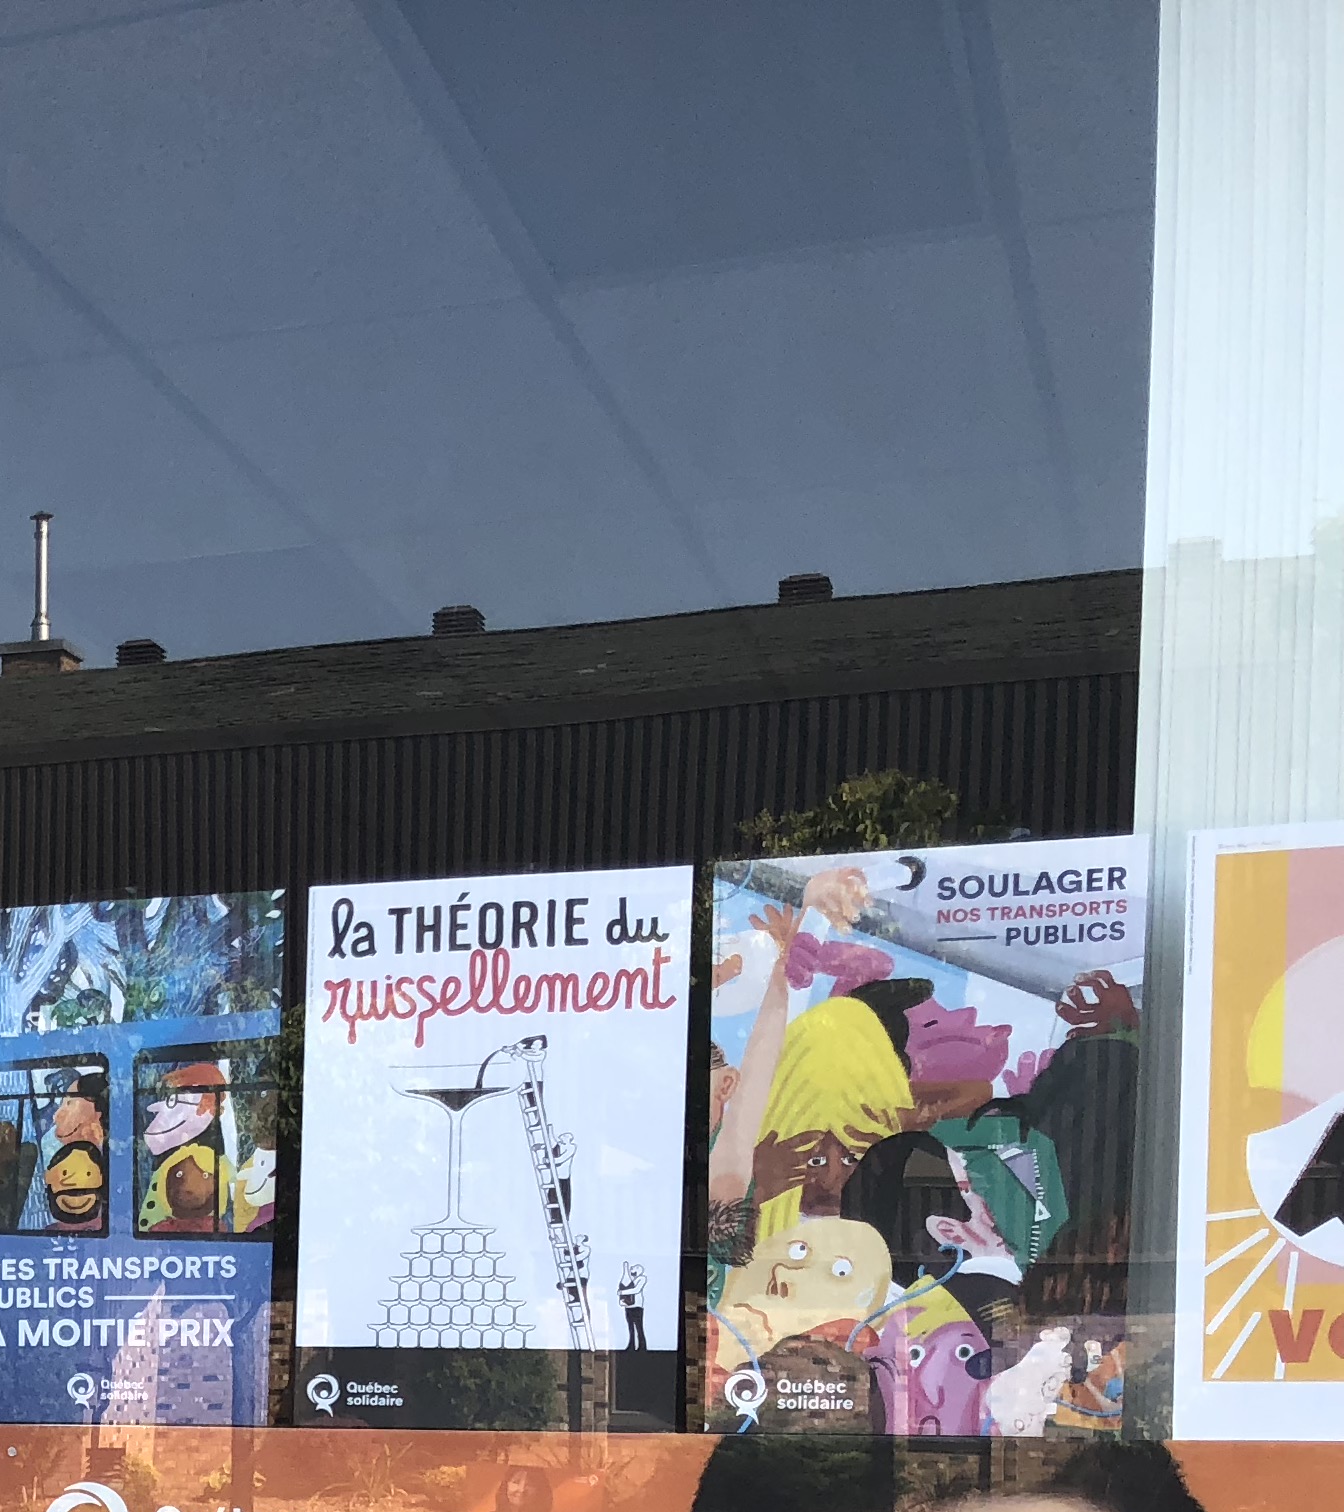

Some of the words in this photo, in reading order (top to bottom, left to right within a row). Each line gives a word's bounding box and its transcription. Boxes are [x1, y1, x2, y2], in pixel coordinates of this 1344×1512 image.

[937, 867, 1127, 900] SOULAGER
[937, 907, 981, 924] NOS
[987, 899, 1128, 921] TRANSPORTS
[328, 898, 377, 959] la
[388, 892, 589, 955] THÉORIE
[606, 897, 670, 945] du
[1005, 921, 1126, 946] PUBLICS
[322, 947, 677, 1048] ruissellement
[43, 1256, 237, 1280] TRANSPORTS
[18, 1312, 146, 1347] MOITIÉ
[159, 1318, 235, 1347] PRIX
[346, 1381, 399, 1394] Québec
[776, 1379, 847, 1393] Québec
[346, 1395, 403, 1406] solidaire
[777, 1396, 853, 1410] solidaire
